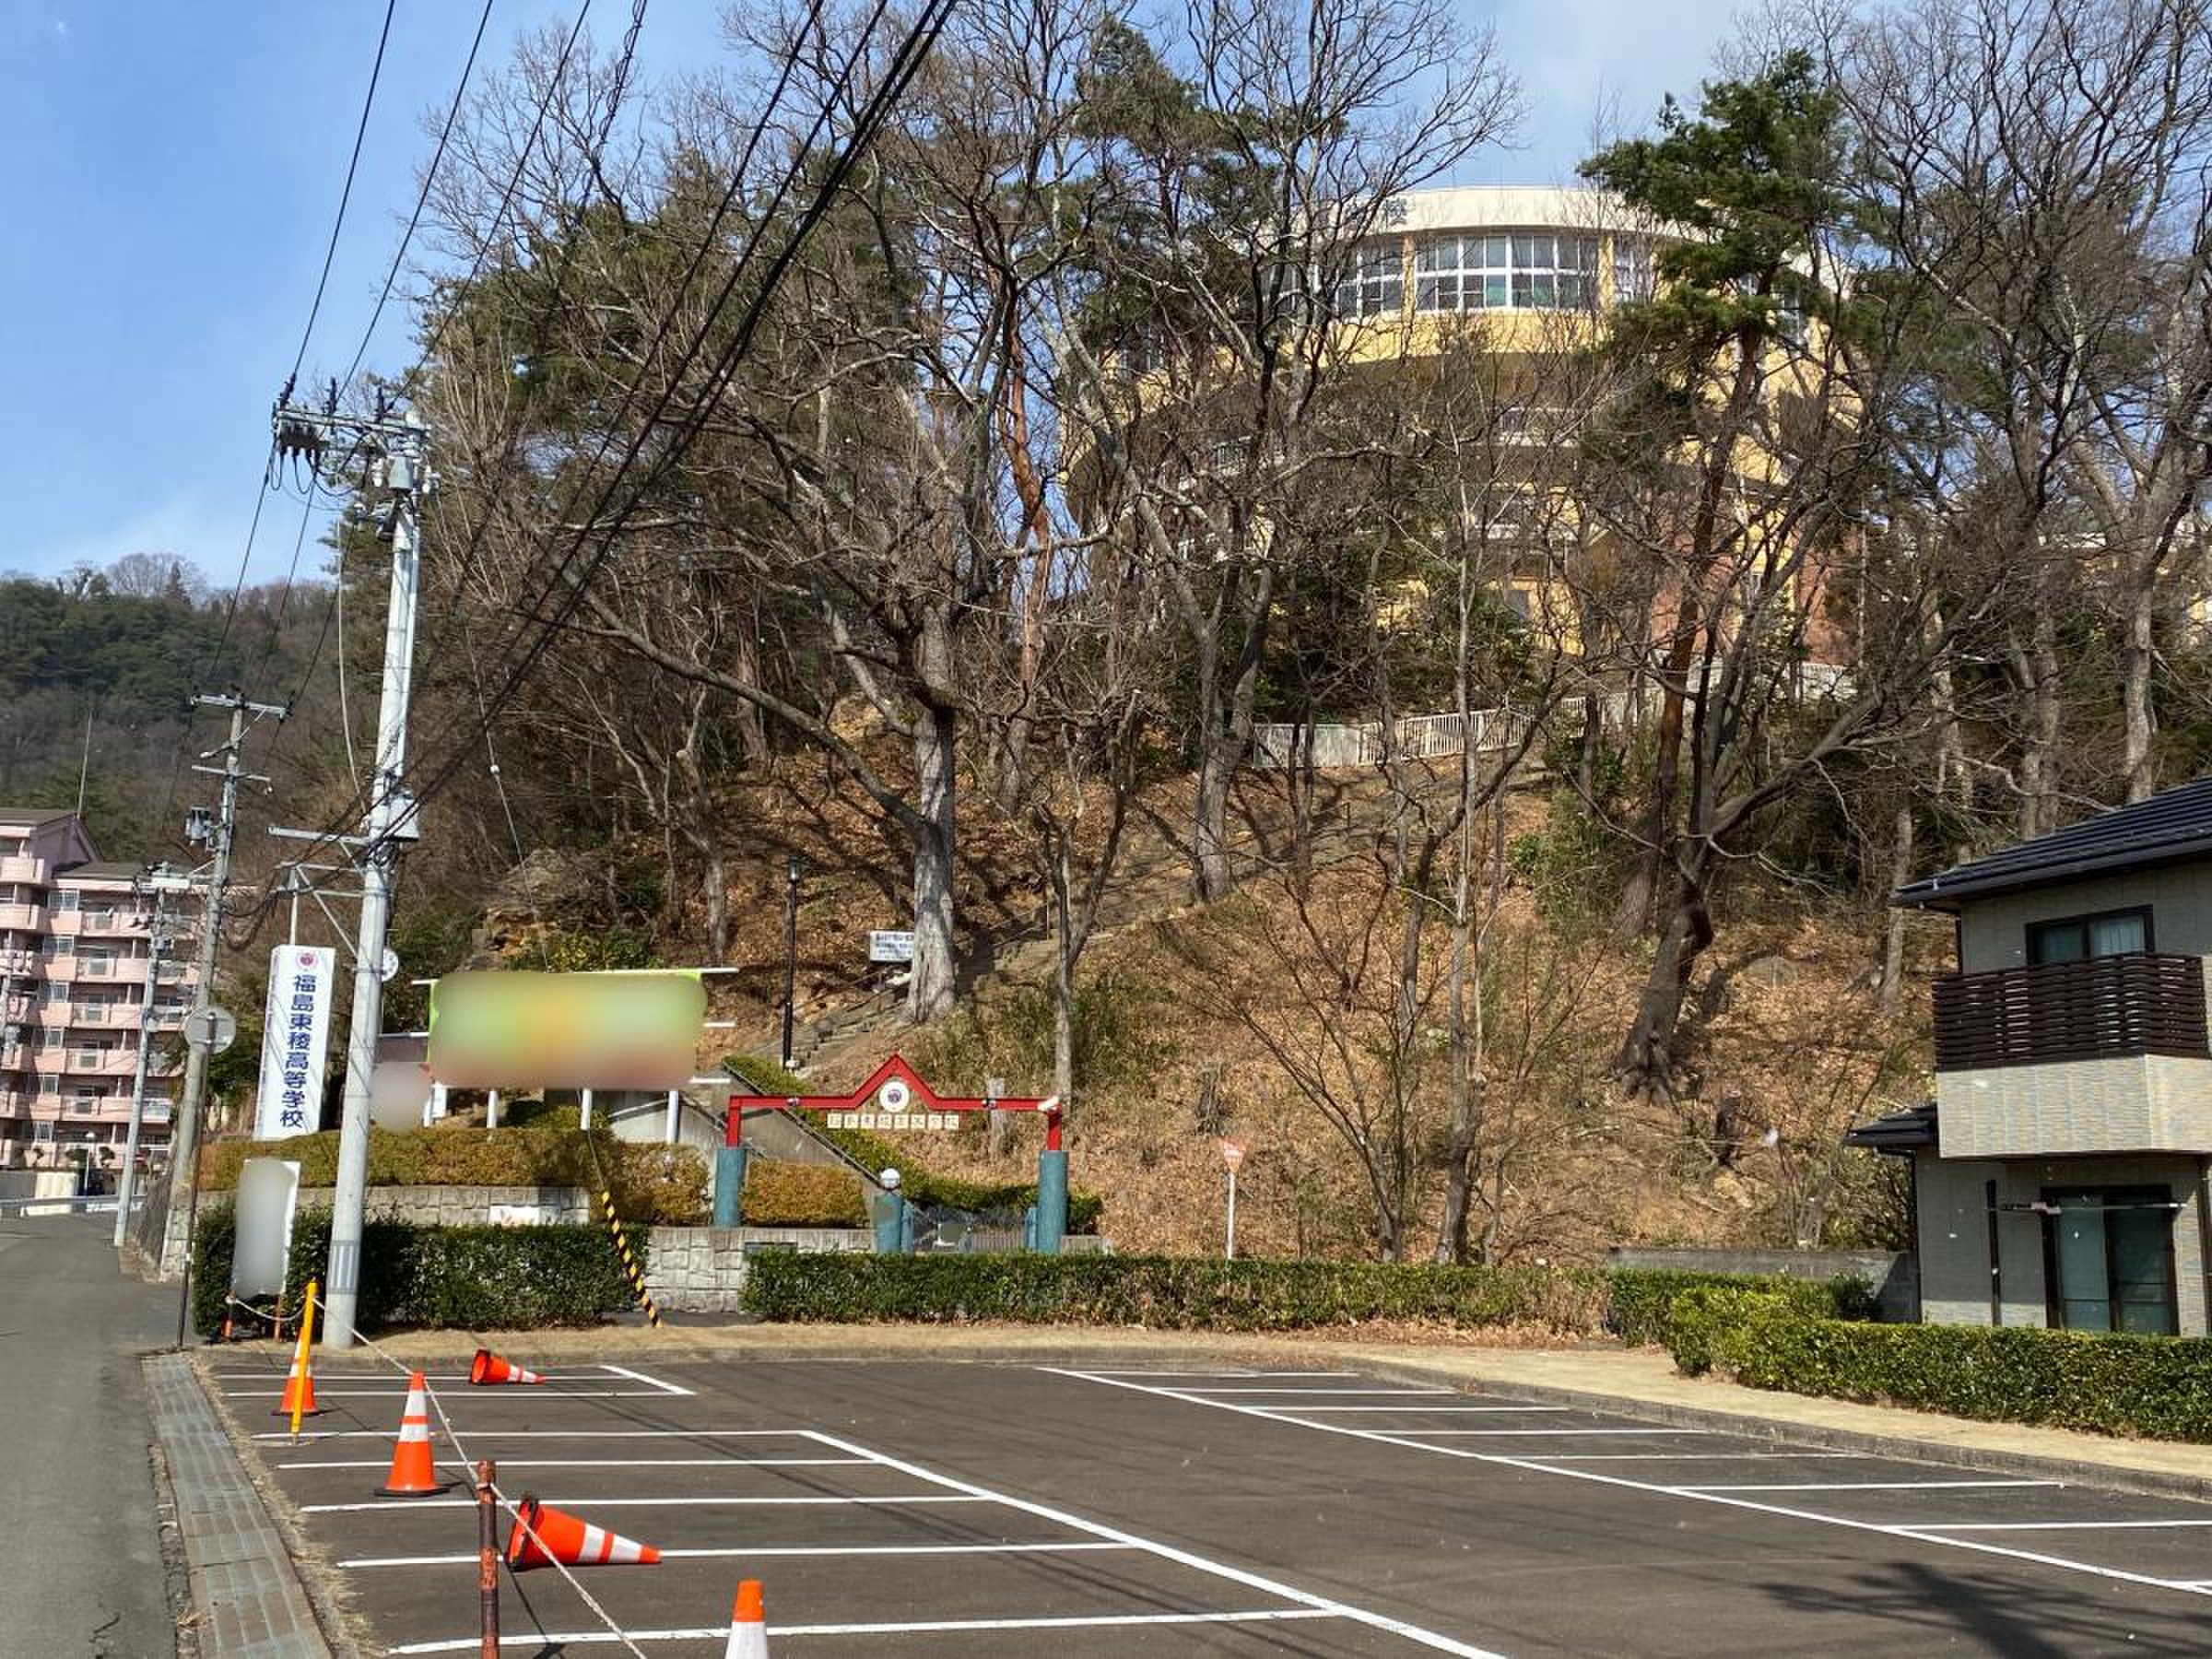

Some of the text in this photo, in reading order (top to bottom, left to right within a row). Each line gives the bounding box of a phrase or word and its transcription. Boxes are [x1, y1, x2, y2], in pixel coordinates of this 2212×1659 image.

[279, 974, 317, 1129] 福島東稜高等学校
